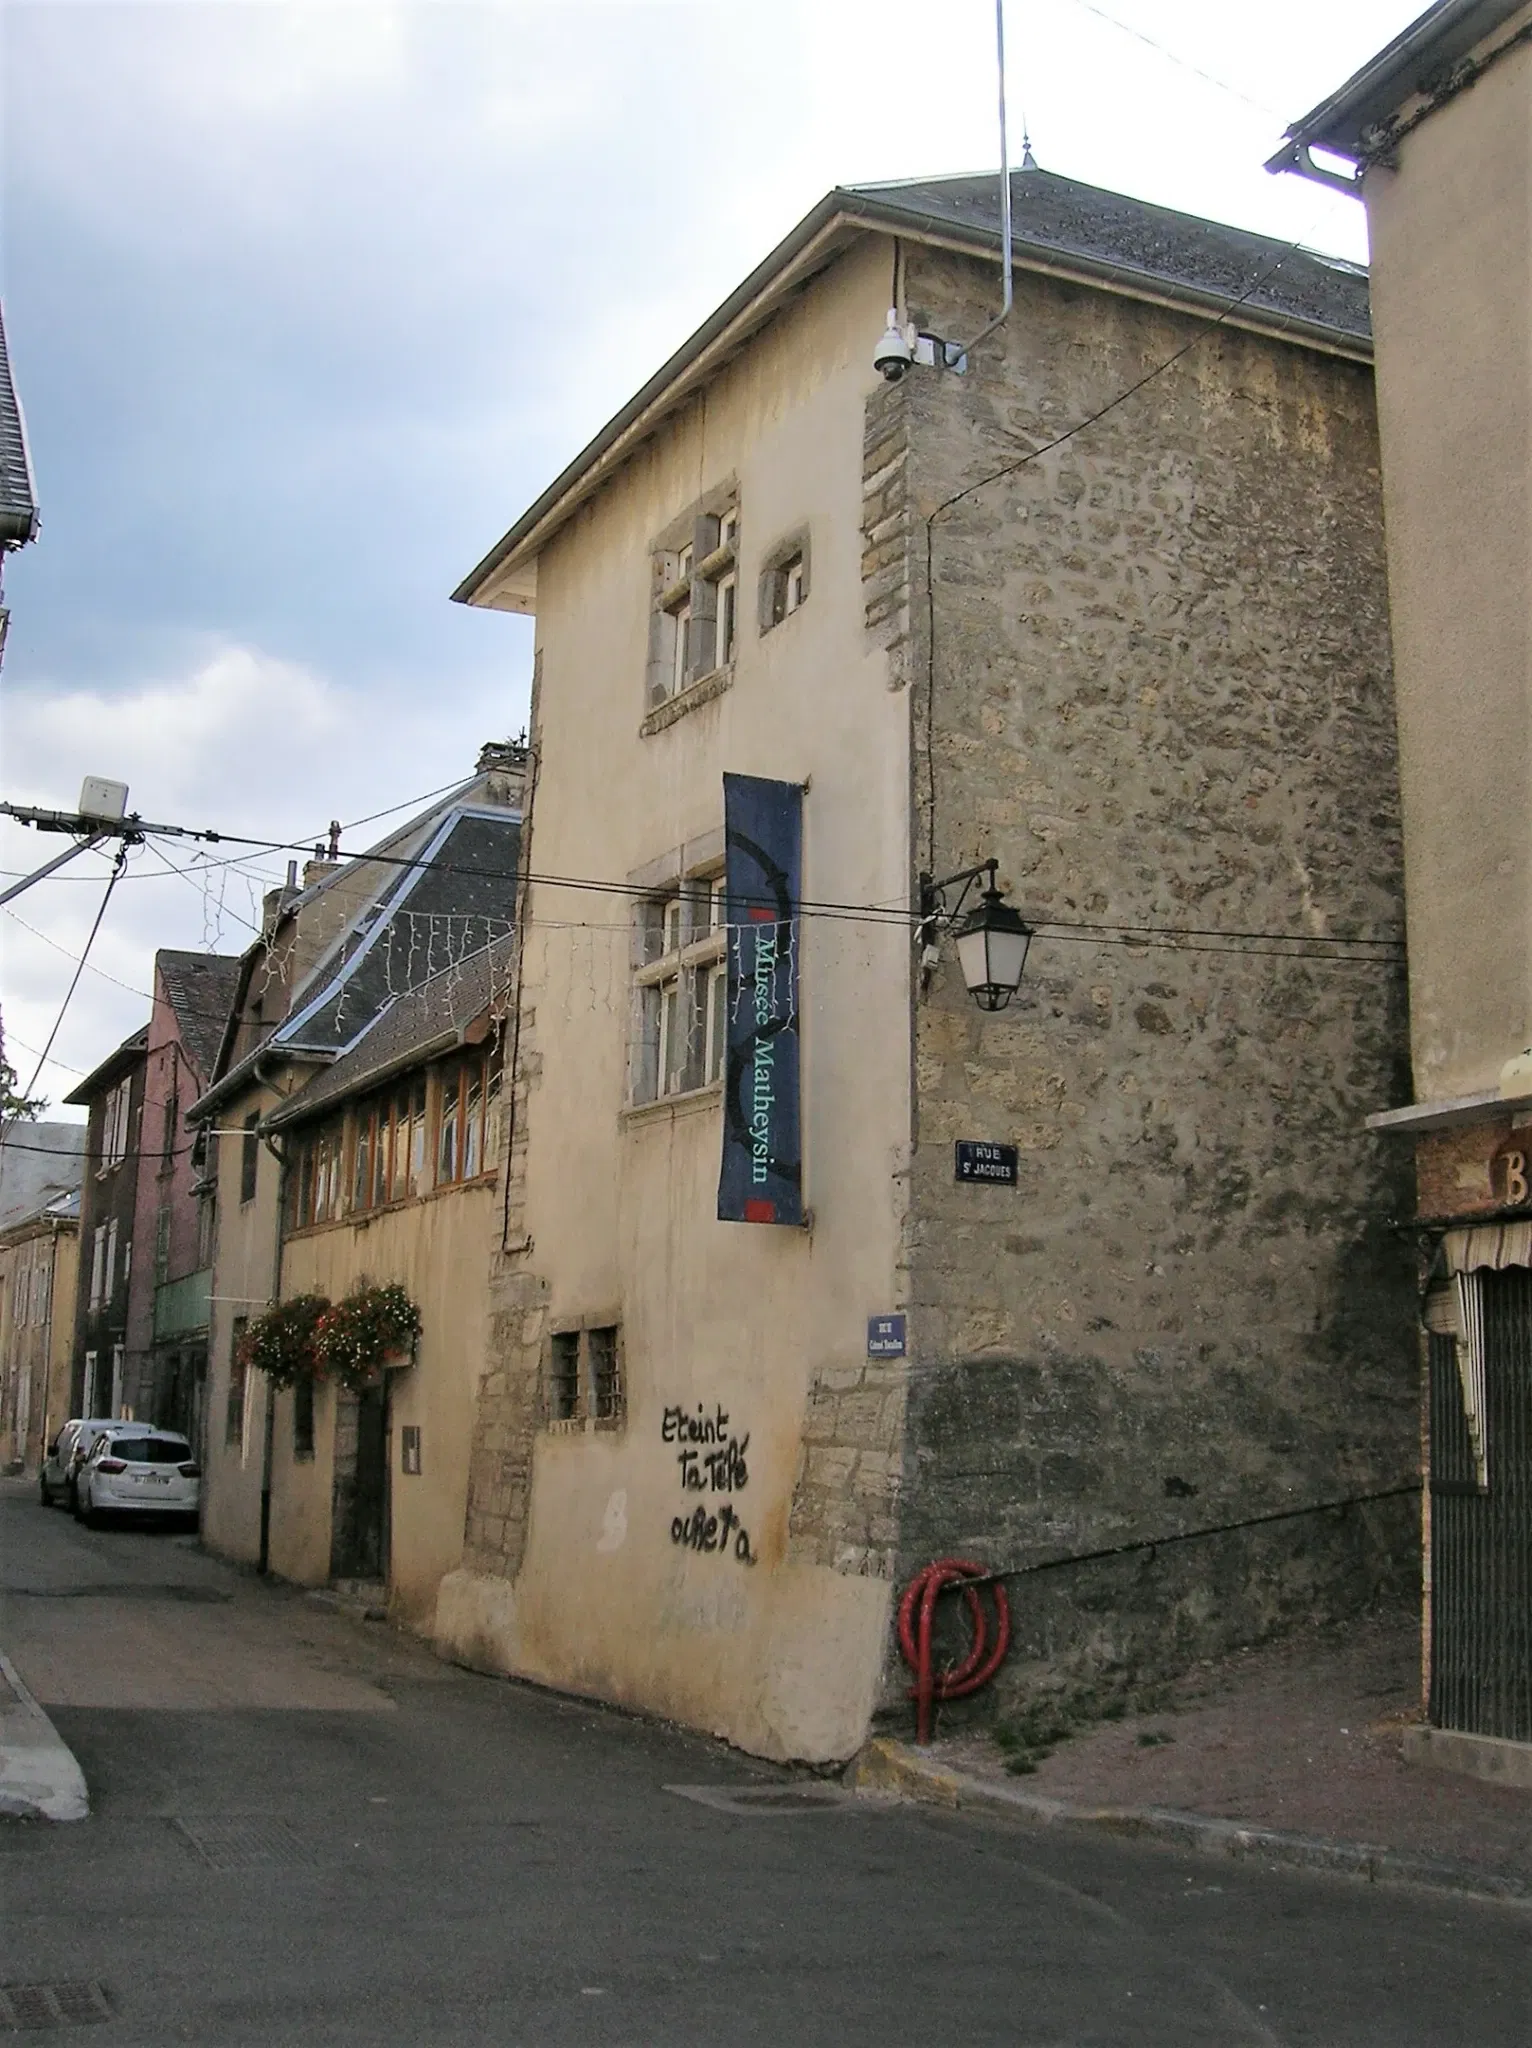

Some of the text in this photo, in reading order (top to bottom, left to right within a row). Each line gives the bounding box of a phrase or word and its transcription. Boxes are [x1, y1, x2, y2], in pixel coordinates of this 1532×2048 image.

[749, 1037, 776, 1184] Matheysin
[976, 1147, 1001, 1160] RUE
[973, 1163, 1011, 1178] JACQUES
[662, 1403, 729, 1443] Eteint
